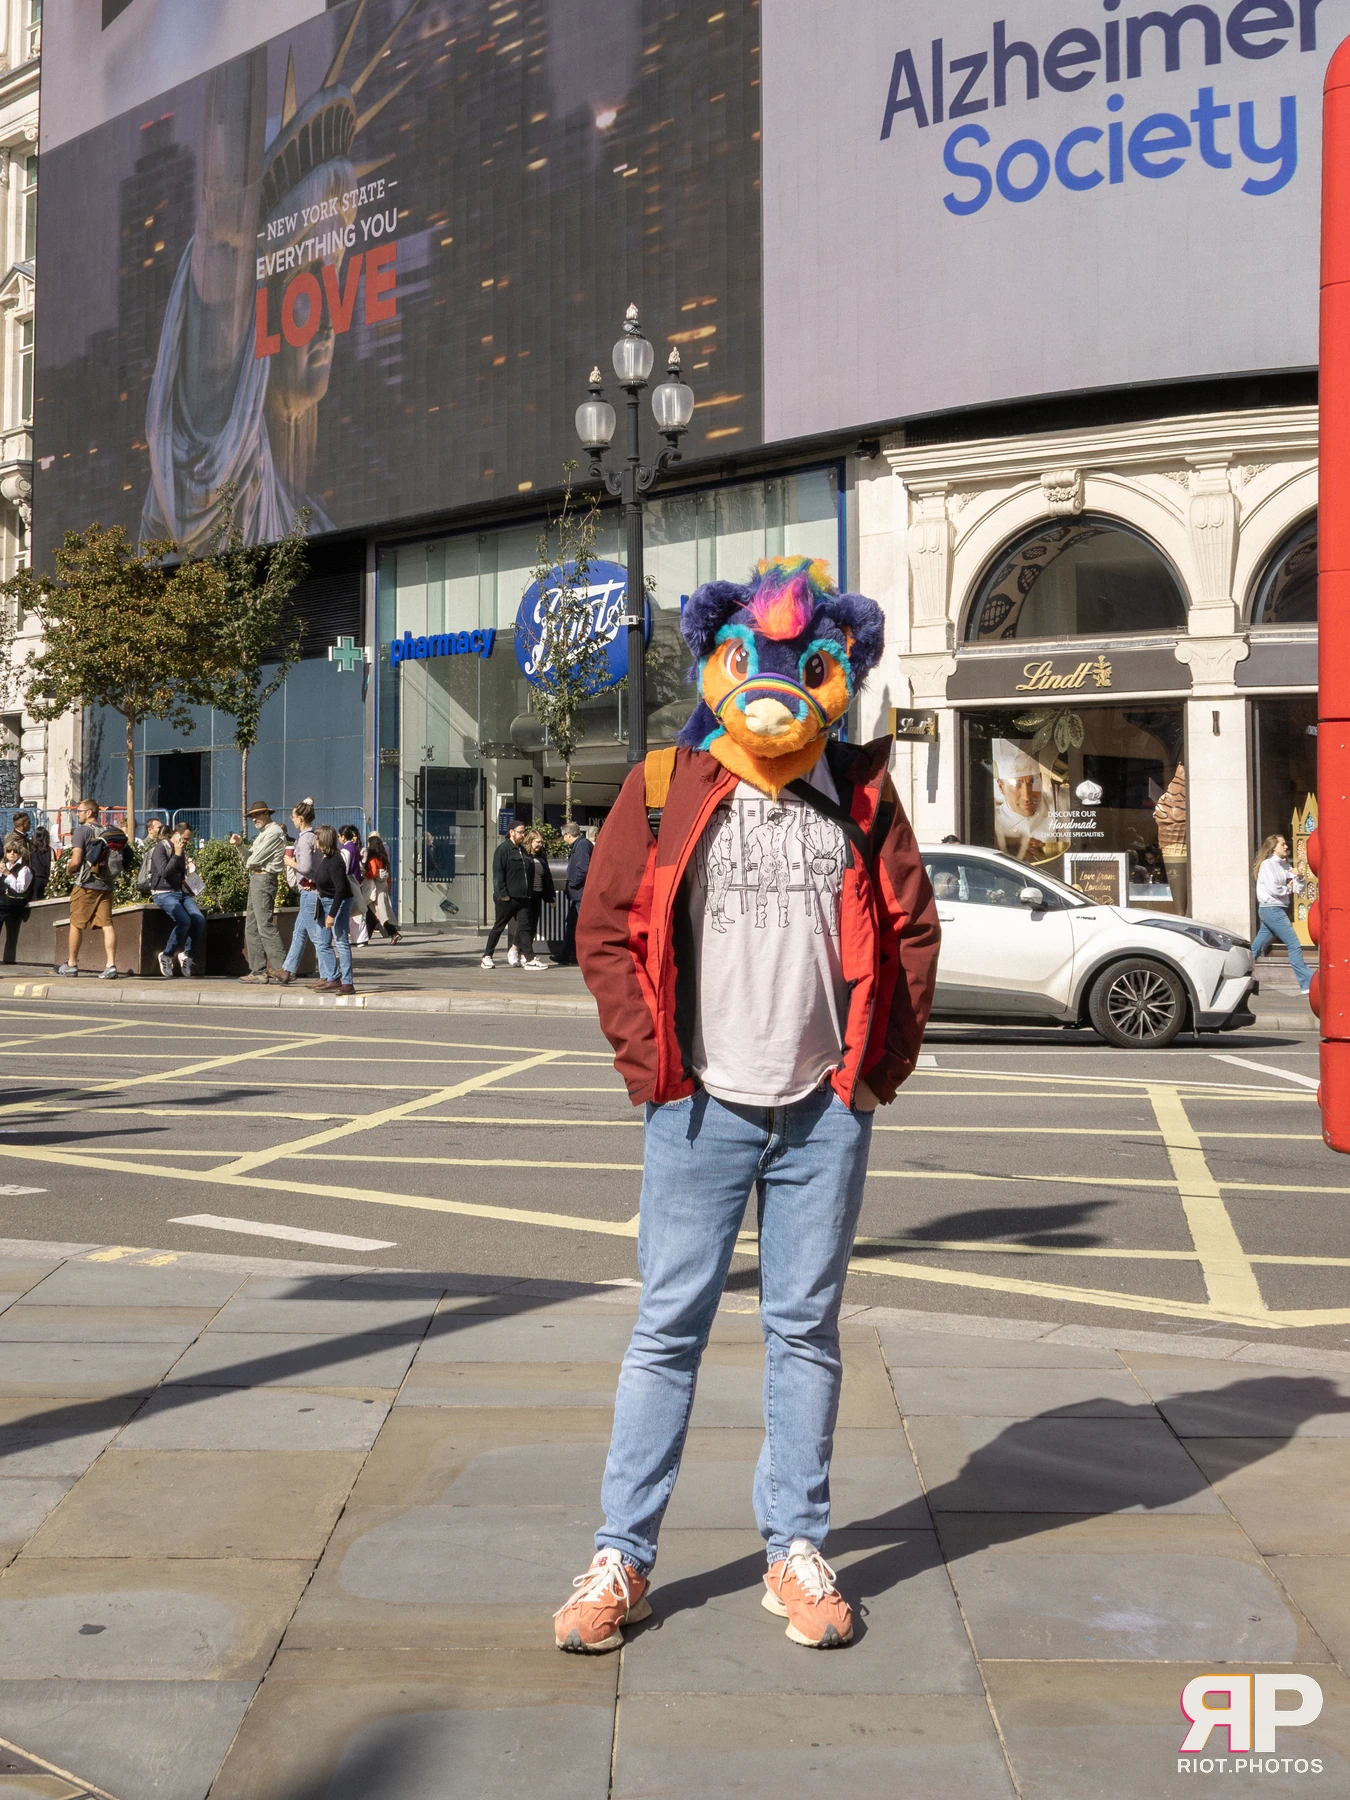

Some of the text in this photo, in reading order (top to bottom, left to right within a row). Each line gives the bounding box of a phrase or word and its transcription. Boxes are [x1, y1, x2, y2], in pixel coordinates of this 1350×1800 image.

[880, 0, 1323, 141] Alzheimer
[943, 86, 1298, 216] Society
[267, 178, 386, 241] NEW YORK STATE
[256, 207, 397, 280] EVERYTHING YOU
[255, 241, 397, 360] LOVE
[391, 627, 496, 668] pharmacy
[524, 579, 626, 676] Boots
[1015, 660, 1093, 692] Lindt
[588, 817, 607, 828] DIO
[1047, 810, 1097, 818] DISCOVER OUR
[1048, 818, 1097, 830] Handmade
[1079, 871, 1116, 883] Love from
[1084, 881, 1112, 892] London
